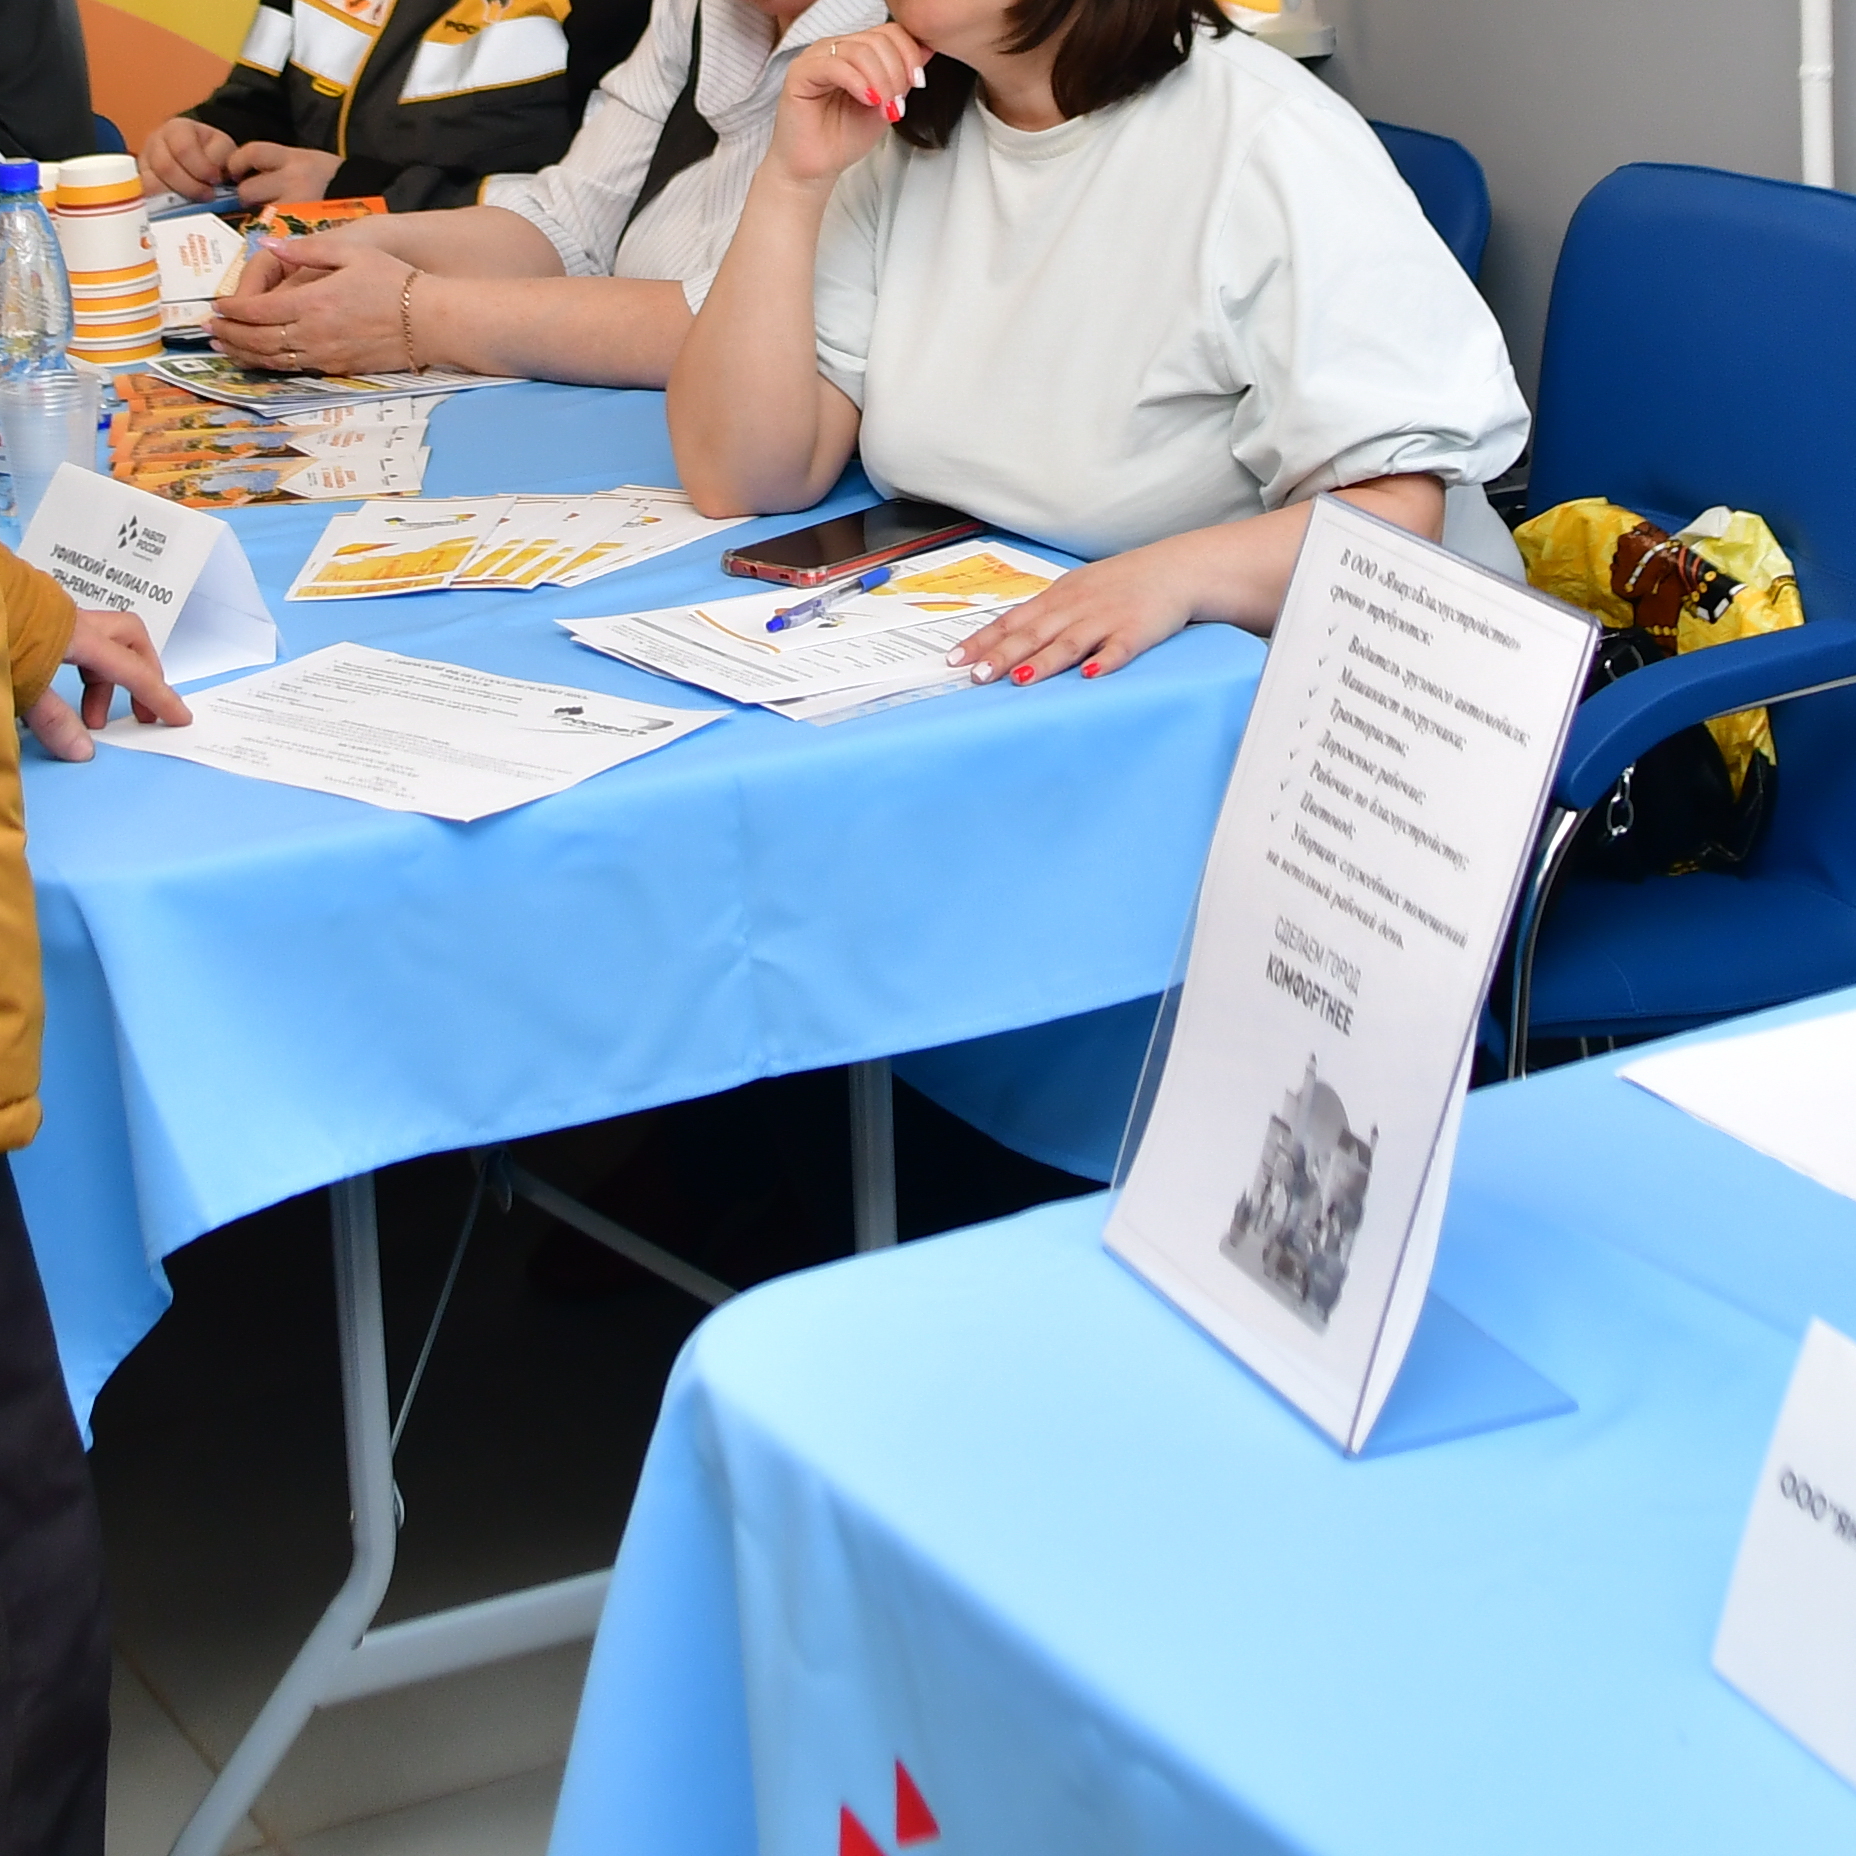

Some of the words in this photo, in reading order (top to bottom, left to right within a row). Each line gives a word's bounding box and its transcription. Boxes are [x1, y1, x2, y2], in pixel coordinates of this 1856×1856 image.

[49, 543, 108, 577] УФИМСКИЙ
[105, 566, 149, 595] ФИЛИАЛ
[148, 584, 173, 605] ООО
[1340, 548, 1351, 567] В
[1351, 554, 1378, 580] ООО
[1330, 584, 1365, 609] срочно
[1338, 667, 1400, 709] Машинист
[1348, 634, 1400, 677] Водитель
[1401, 669, 1453, 705] грузового
[1318, 728, 1377, 776] Дорожные
[1310, 759, 1353, 800] Рабочие
[1354, 791, 1368, 808] по
[1266, 849, 1280, 867] на
[1280, 859, 1332, 901] неполный
[1331, 891, 1378, 930] рабочий
[1291, 820, 1340, 866] Уборщик
[1340, 861, 1402, 908] служебных
[1403, 897, 1468, 950] помещений
[1275, 914, 1324, 968] СДЕЛАЕМ
[1324, 948, 1361, 998] ГОРОД
[1266, 950, 1354, 1037] КОМФОРТНЕЕ
[1779, 1468, 1828, 1521] ООО
